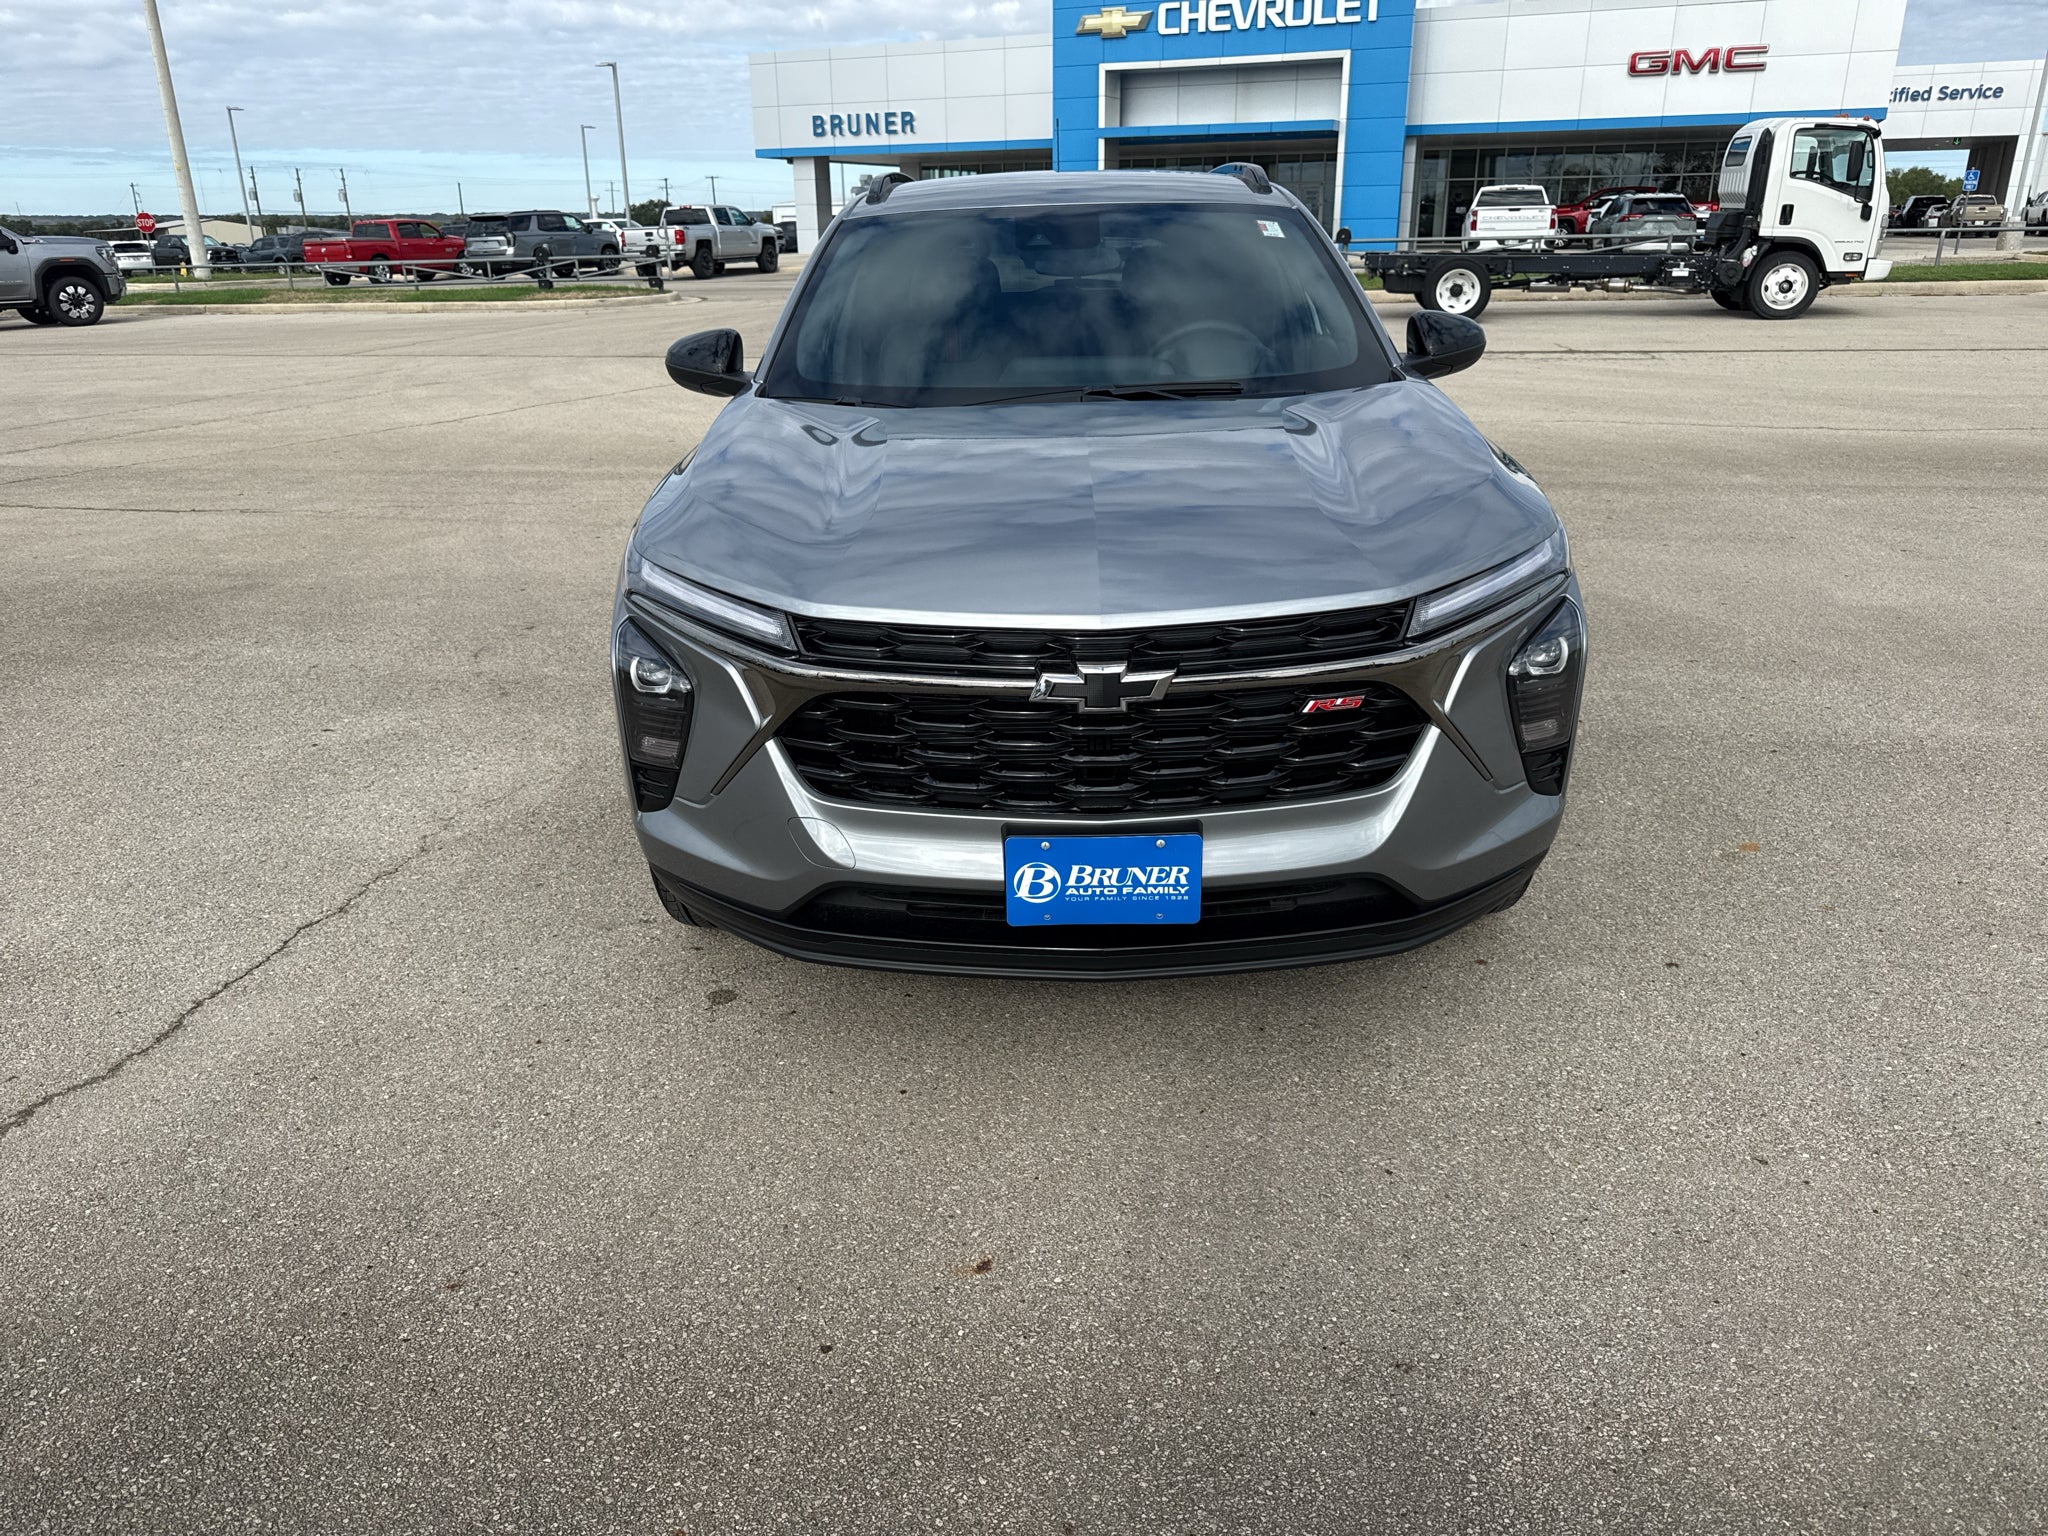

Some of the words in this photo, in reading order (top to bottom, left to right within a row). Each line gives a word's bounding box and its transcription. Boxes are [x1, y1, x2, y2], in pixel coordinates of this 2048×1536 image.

[1628, 44, 1770, 76] GMC
[1937, 84, 2004, 101] Service
[812, 111, 916, 137] BRUNER
[137, 218, 154, 227] STOP
[1302, 695, 1365, 713] RS
[1014, 867, 1056, 898] B
[1065, 865, 1190, 886] BRUNER
[1065, 887, 1117, 895] AUTO
[1122, 886, 1190, 894] FAMILY
